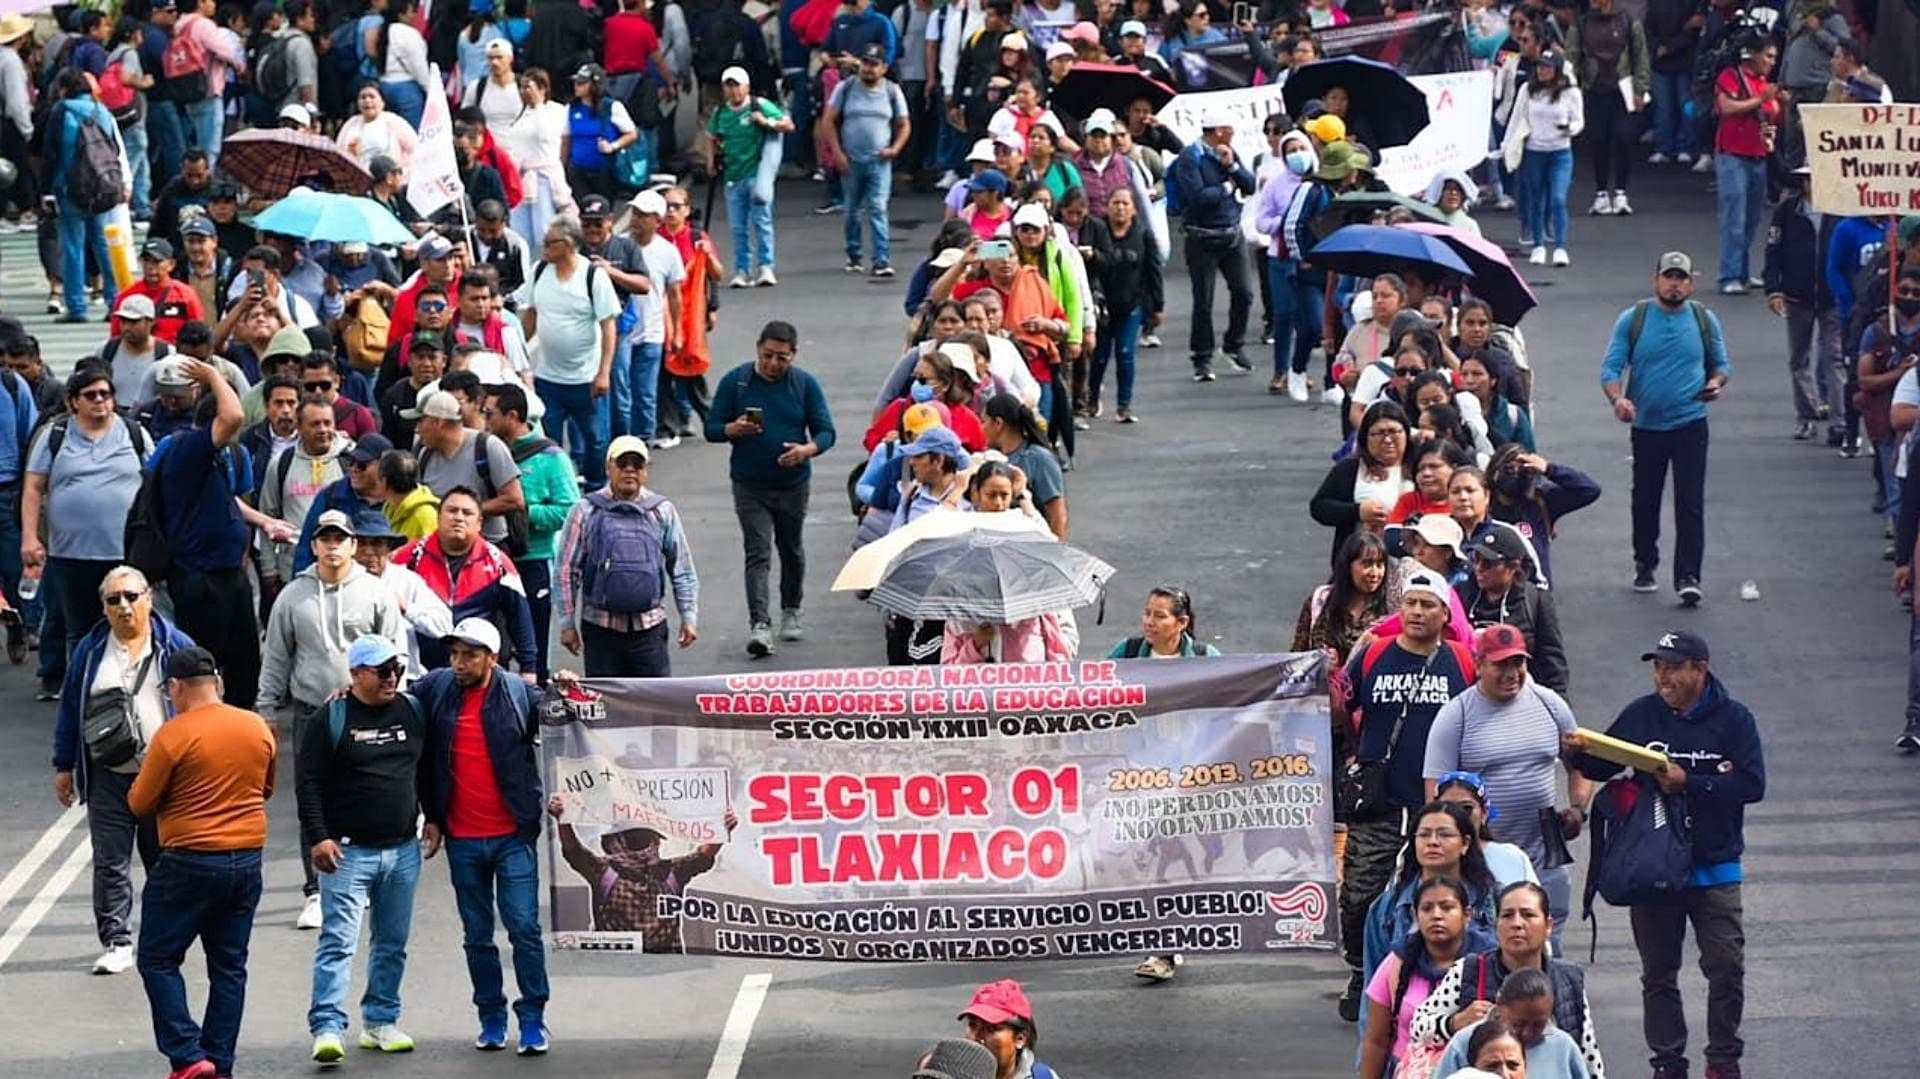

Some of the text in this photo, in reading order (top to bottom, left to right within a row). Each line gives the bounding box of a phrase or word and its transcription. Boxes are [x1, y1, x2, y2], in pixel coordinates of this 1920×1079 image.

[1857, 182, 1900, 208] YUKU
[728, 662, 1115, 690] COORDINADORA NACIONAL DE
[698, 682, 1146, 714] TRABAJADORES DE LA EDUCACIÓN
[773, 715, 911, 740] SECCIÓN
[999, 711, 1137, 736] OAXACA
[565, 769, 595, 794] NO
[1109, 754, 1314, 791] 2006. 2013. 2016.
[748, 766, 1079, 824] SECTOR 01
[1148, 784, 1323, 818] PERDONAMOS!
[1160, 807, 1313, 837] OLVIDAMOS!
[761, 829, 1067, 885] TLAXIACO
[658, 892, 1264, 933] ¡POR LA EDUCACIÓN AL SERVICIO DEL PUEBLO!
[717, 925, 1241, 961] ¡UNIDOS Y ORGANIZADOS VENCEREMOS!
